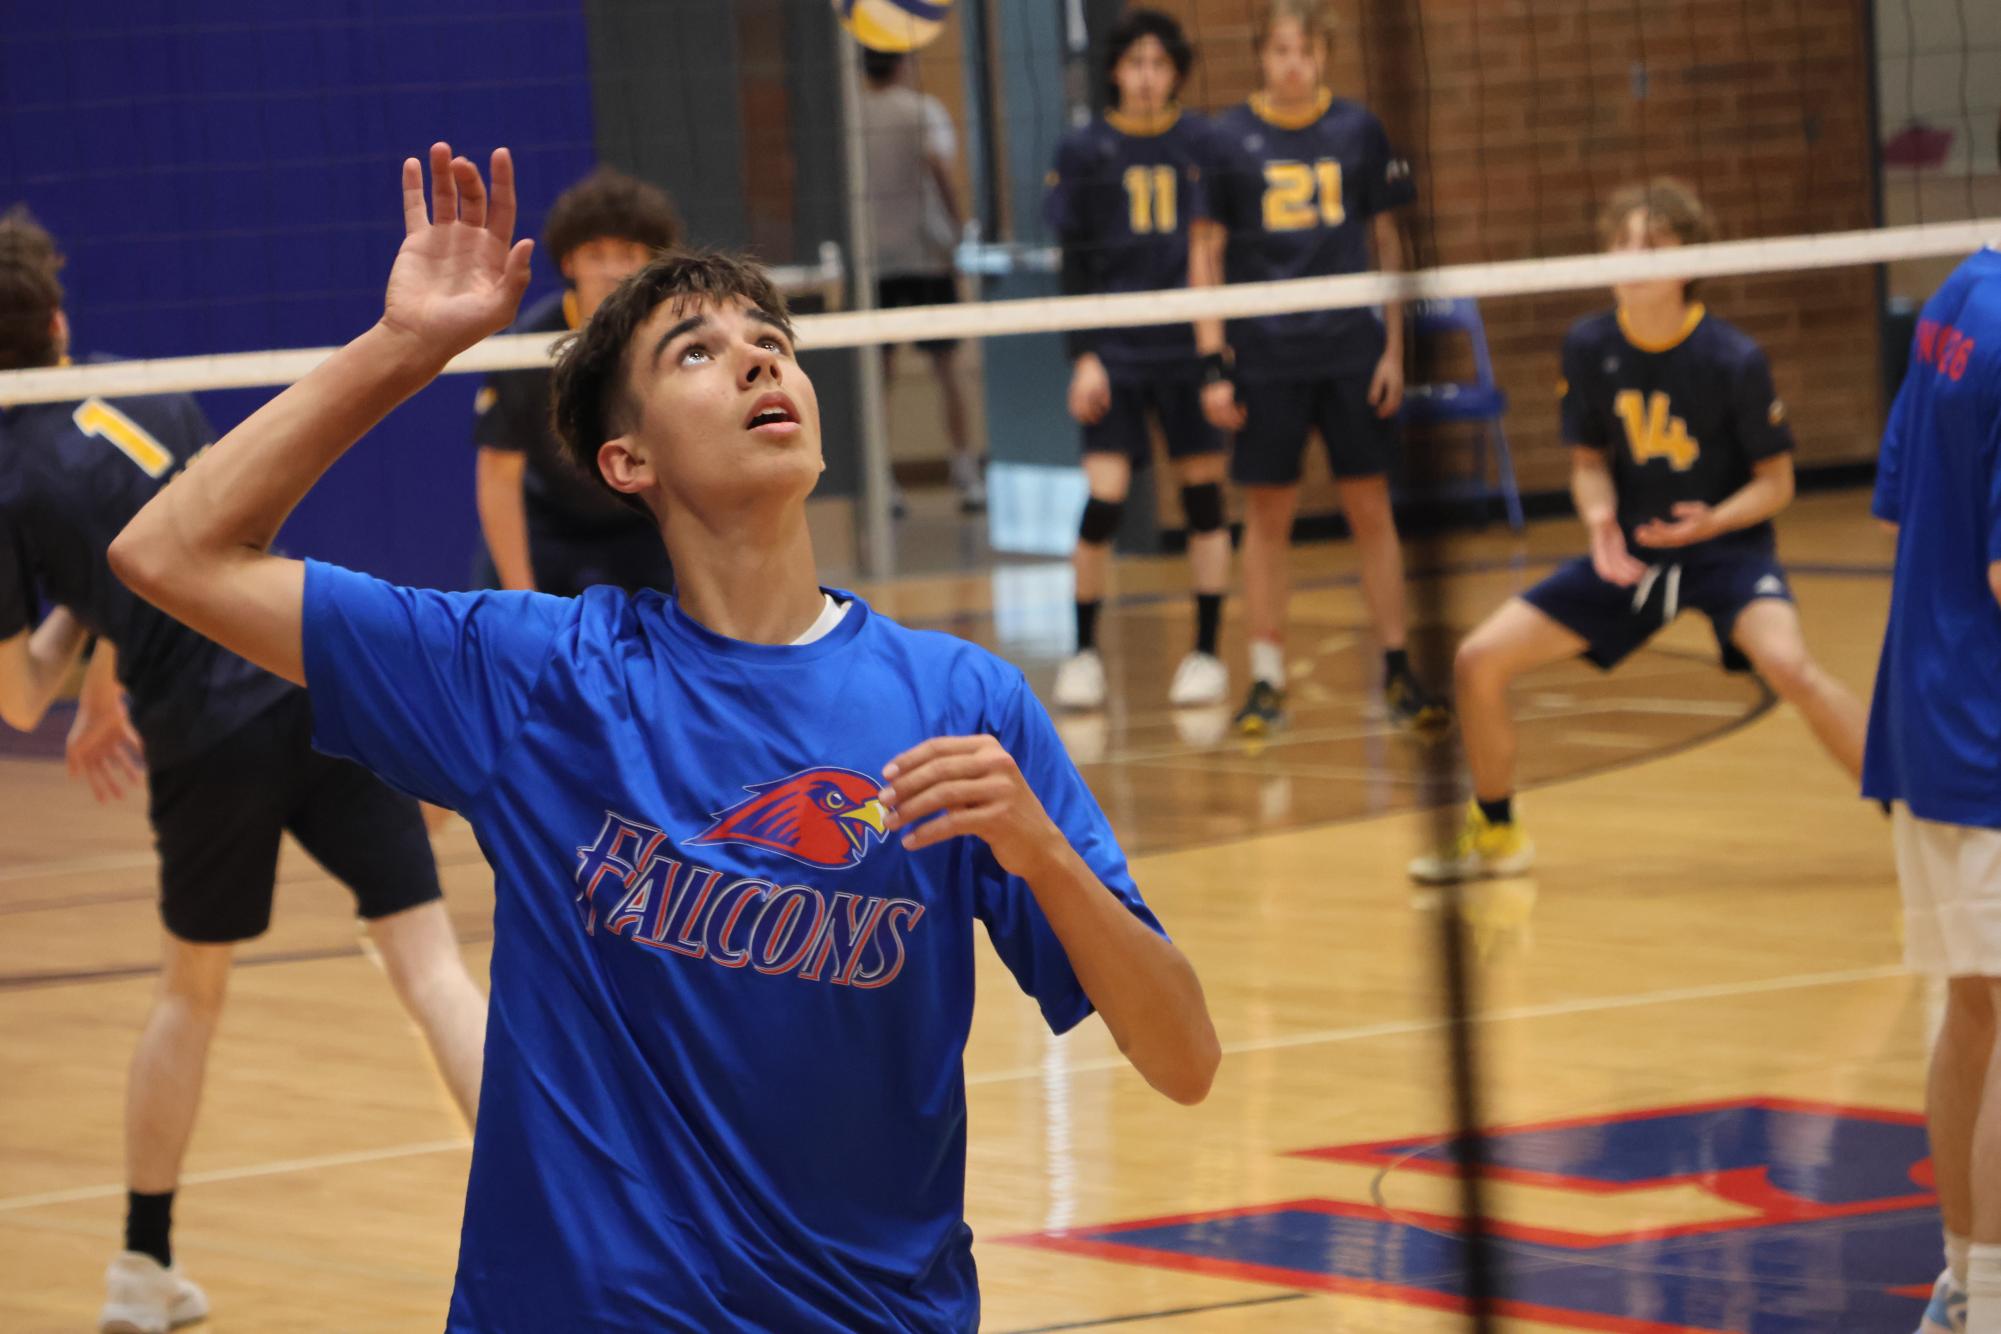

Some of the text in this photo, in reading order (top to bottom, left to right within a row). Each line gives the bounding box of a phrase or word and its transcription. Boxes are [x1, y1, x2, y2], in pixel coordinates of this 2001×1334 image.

[1122, 164, 1177, 234] 11
[1262, 157, 1345, 231] 21
[72, 397, 173, 479] 1
[1615, 389, 1699, 471] 14
[576, 809, 926, 989] FALCONS
